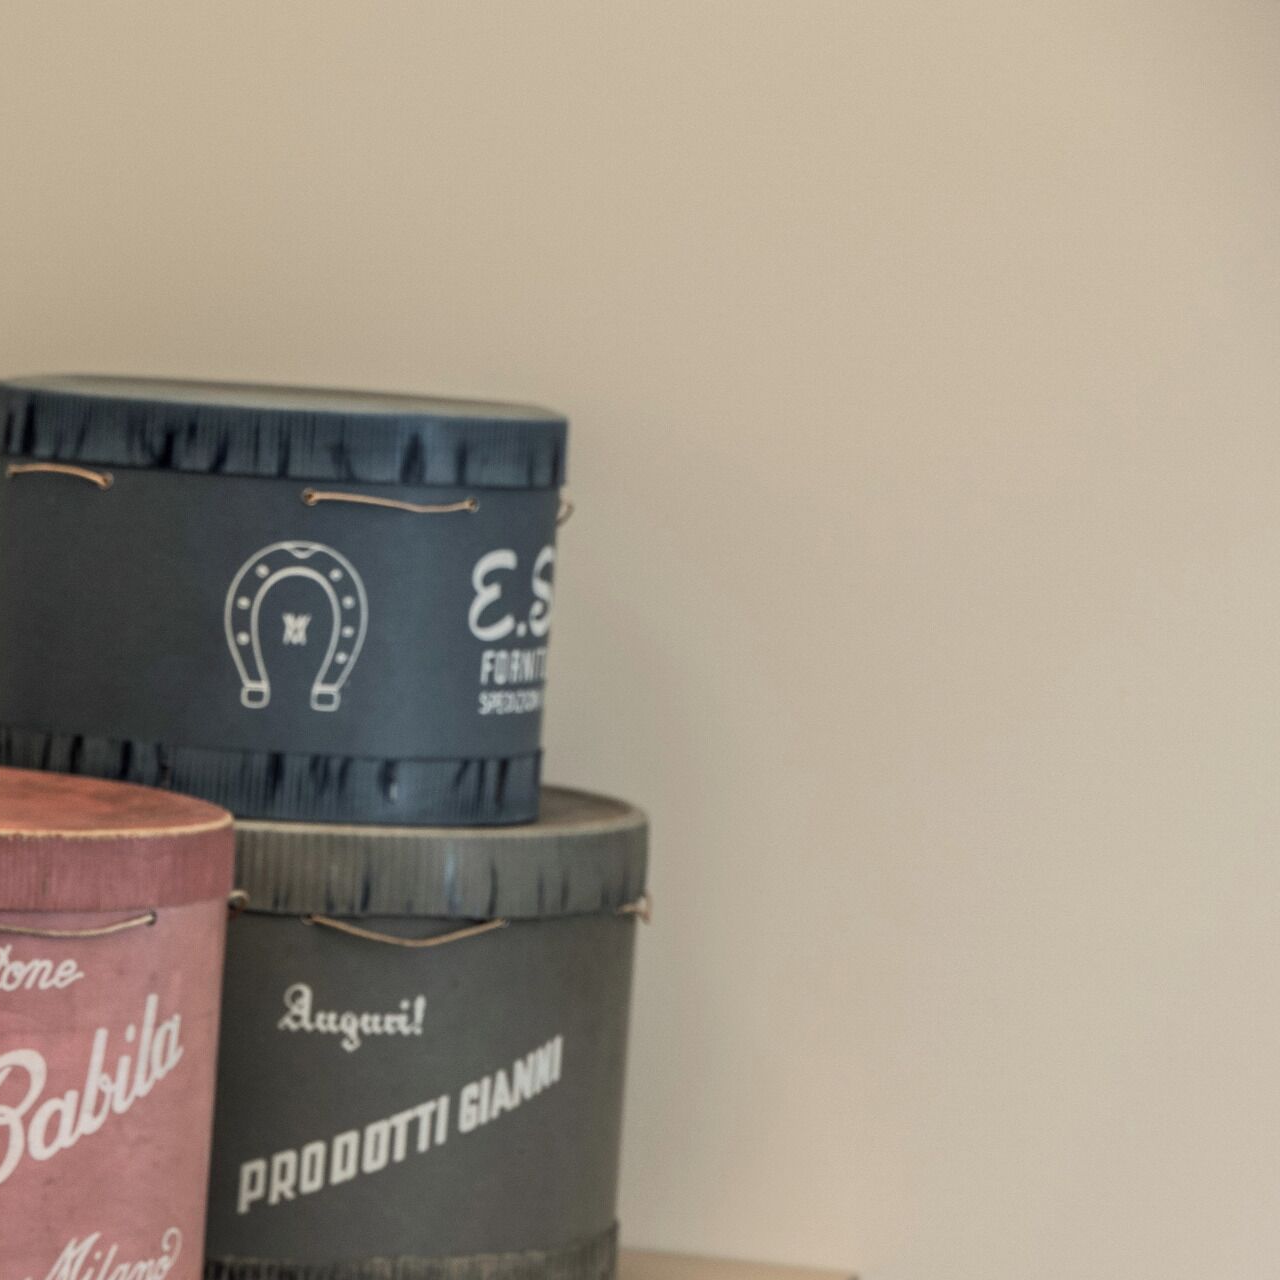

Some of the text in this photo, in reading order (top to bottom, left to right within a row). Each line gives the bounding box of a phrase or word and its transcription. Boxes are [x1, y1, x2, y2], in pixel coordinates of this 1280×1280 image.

[278, 982, 427, 1052] Auguri!
[237, 1034, 564, 1214] PRODOTTI GIANNI
